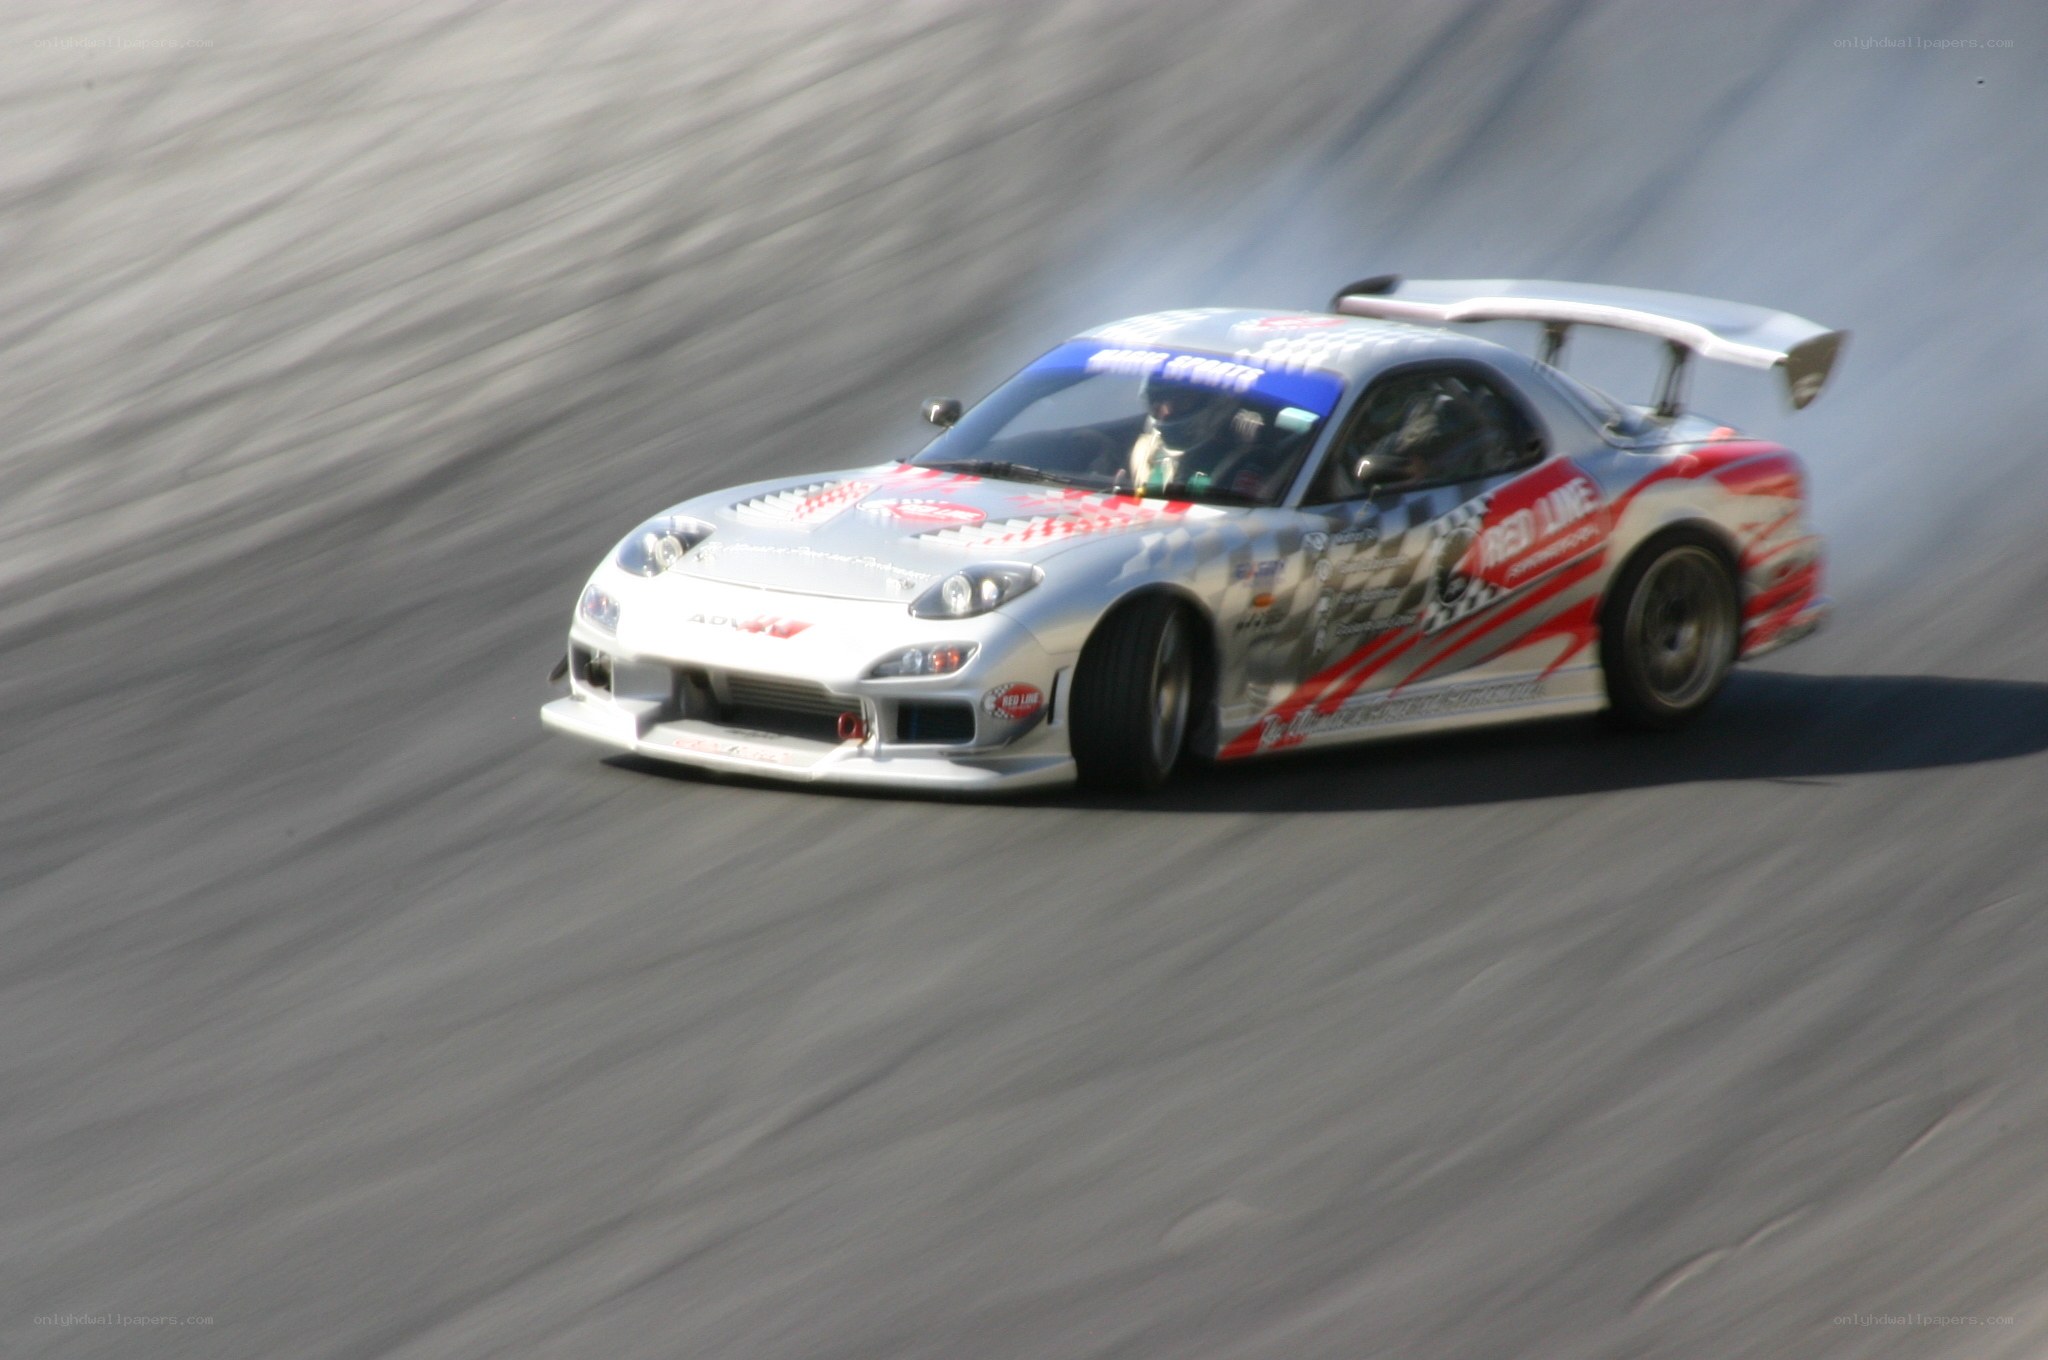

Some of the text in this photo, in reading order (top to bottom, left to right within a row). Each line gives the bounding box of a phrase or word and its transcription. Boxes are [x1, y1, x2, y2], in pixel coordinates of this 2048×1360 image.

[1165, 355, 1265, 389] SPORTS
[1480, 508, 1533, 569] RED
[1537, 477, 1597, 534] LINE
[1002, 695, 1019, 707] RED
